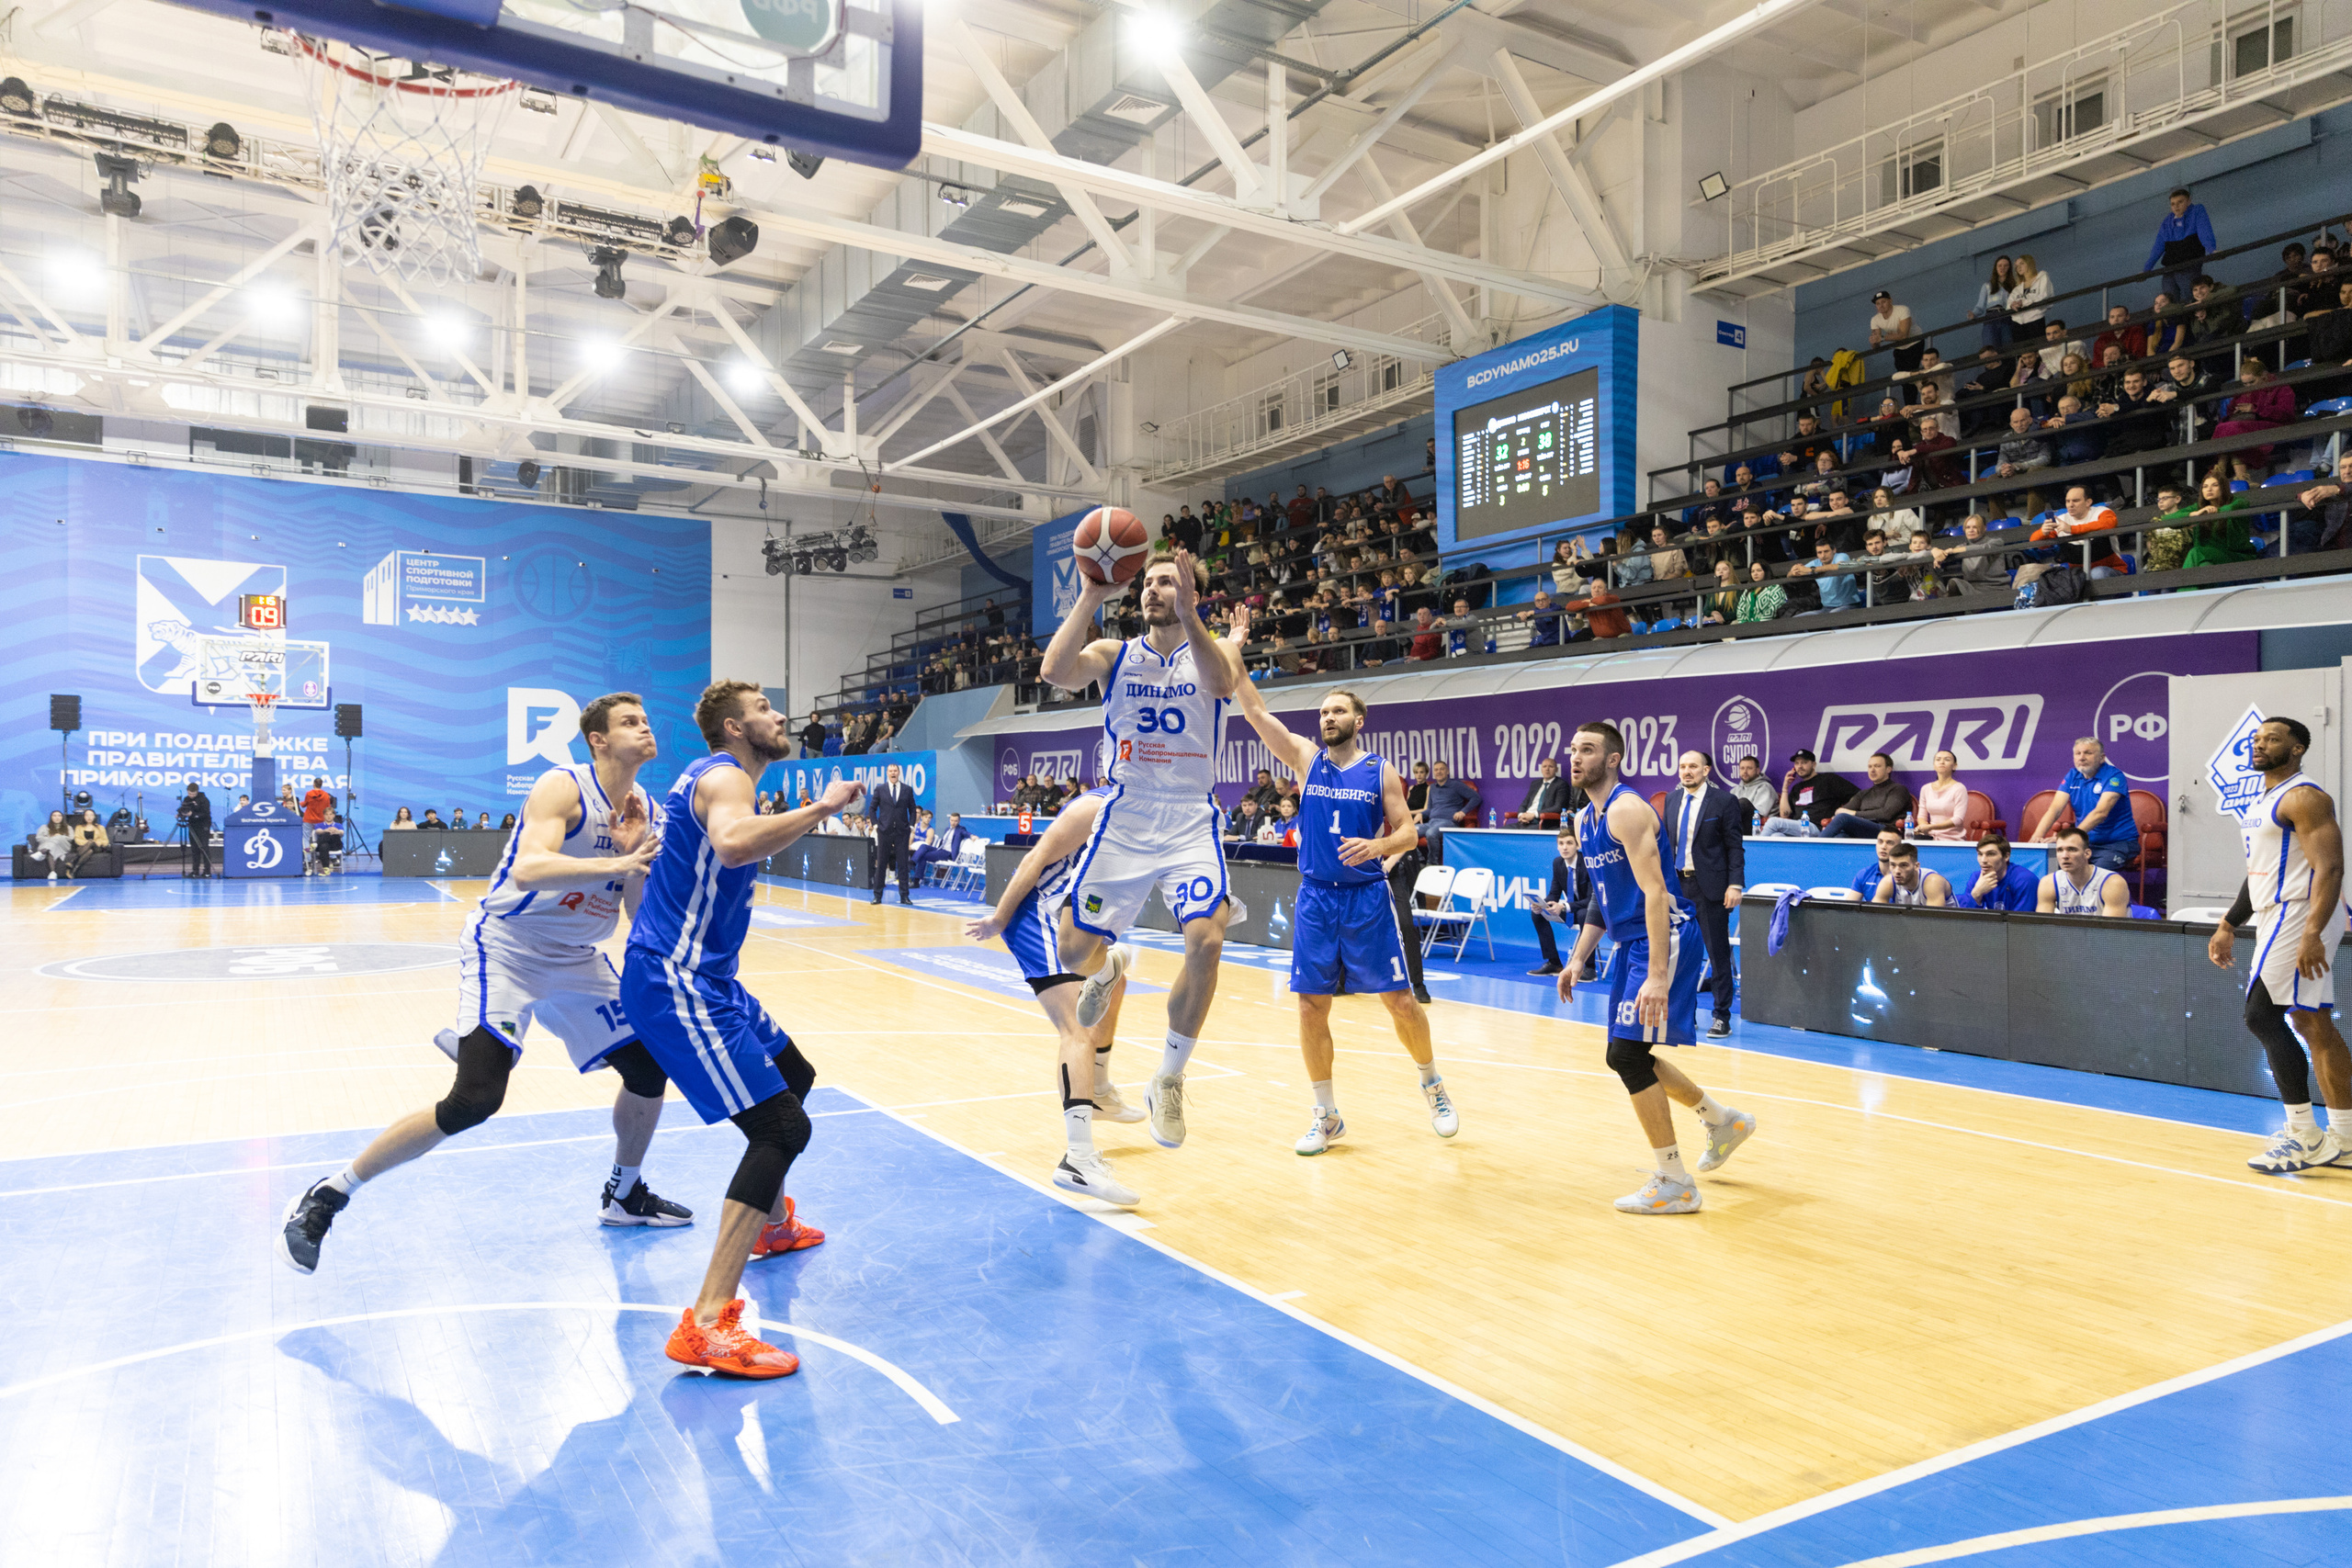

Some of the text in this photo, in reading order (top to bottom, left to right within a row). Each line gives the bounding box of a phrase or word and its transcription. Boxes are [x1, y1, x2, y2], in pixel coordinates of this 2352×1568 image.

[1467, 338, 1579, 389] BCDYNAMO25.RU
[1495, 443, 1510, 462] 32
[406, 558, 439, 567] ЦЕНТР
[406, 567, 474, 579] СПОРТИВНОЙ
[406, 576, 472, 587] ПОДГОТОВКИ
[406, 585, 457, 595] Приморского
[251, 606, 278, 626] 09
[239, 650, 286, 663] PARI
[1136, 707, 1185, 734] 30
[88, 730, 328, 752] ПРИ ПОДДЕЖКЕ
[1818, 704, 2030, 763] PARI
[1138, 740, 1165, 749] Русская
[1138, 748, 1207, 759] Рыбопромышленная
[87, 750, 328, 771] ПРАВИТЕЛЬТВА
[1138, 755, 1171, 764] Компания
[60, 770, 253, 788] ПРИМОРСКОГ
[1306, 784, 1378, 805] НОВОСИБИРСК
[2223, 784, 2238, 794] 1923
[1020, 815, 1031, 832] 5
[1329, 810, 1341, 834] 1
[1390, 956, 1406, 982] 1
